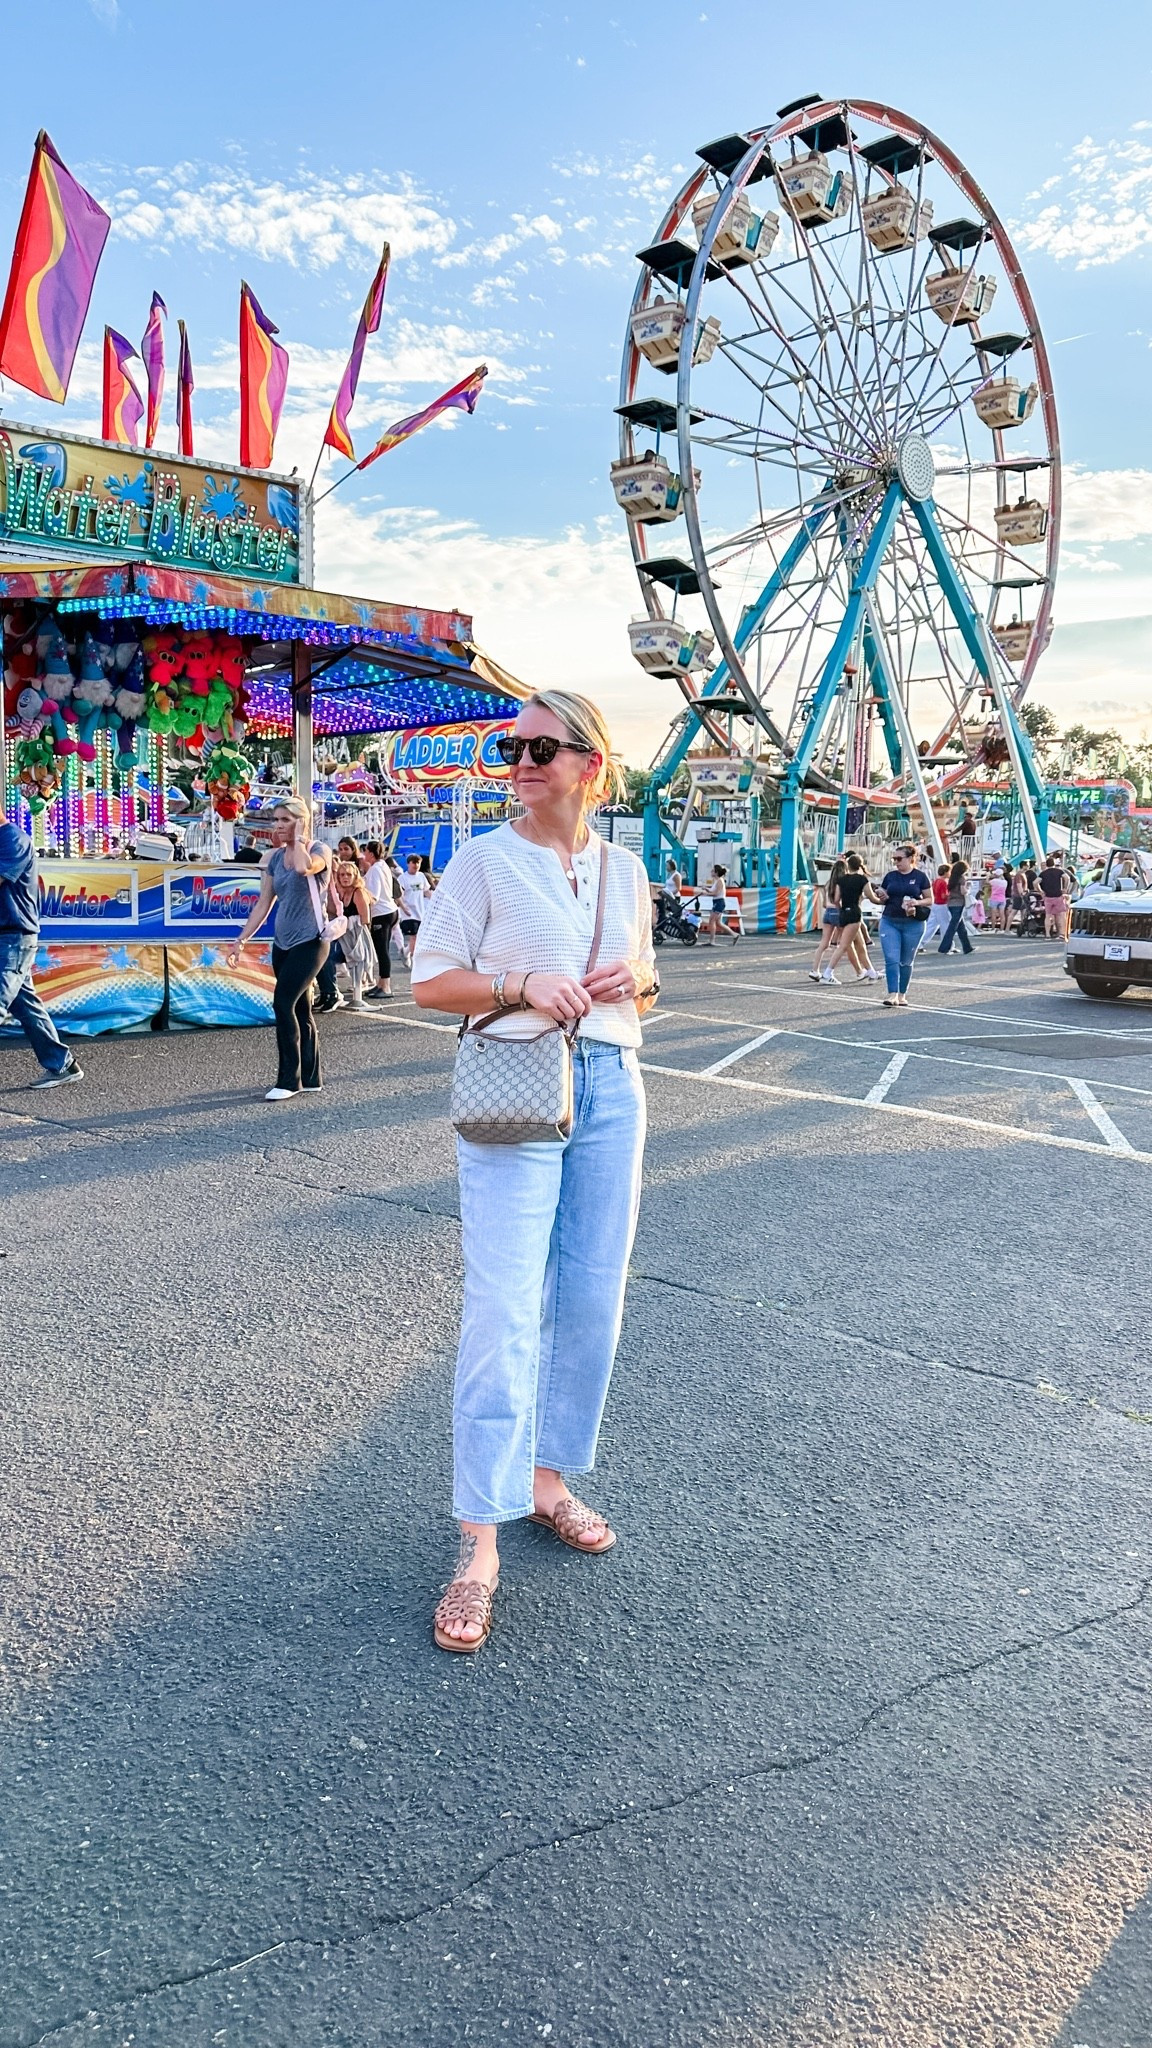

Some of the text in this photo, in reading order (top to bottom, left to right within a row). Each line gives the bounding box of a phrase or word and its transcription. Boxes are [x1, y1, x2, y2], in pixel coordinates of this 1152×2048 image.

[0, 430, 299, 571] Water Blaster
[393, 732, 478, 770] LADDER
[426, 786, 469, 804] LADD
[37, 874, 260, 917] Water Blaster
